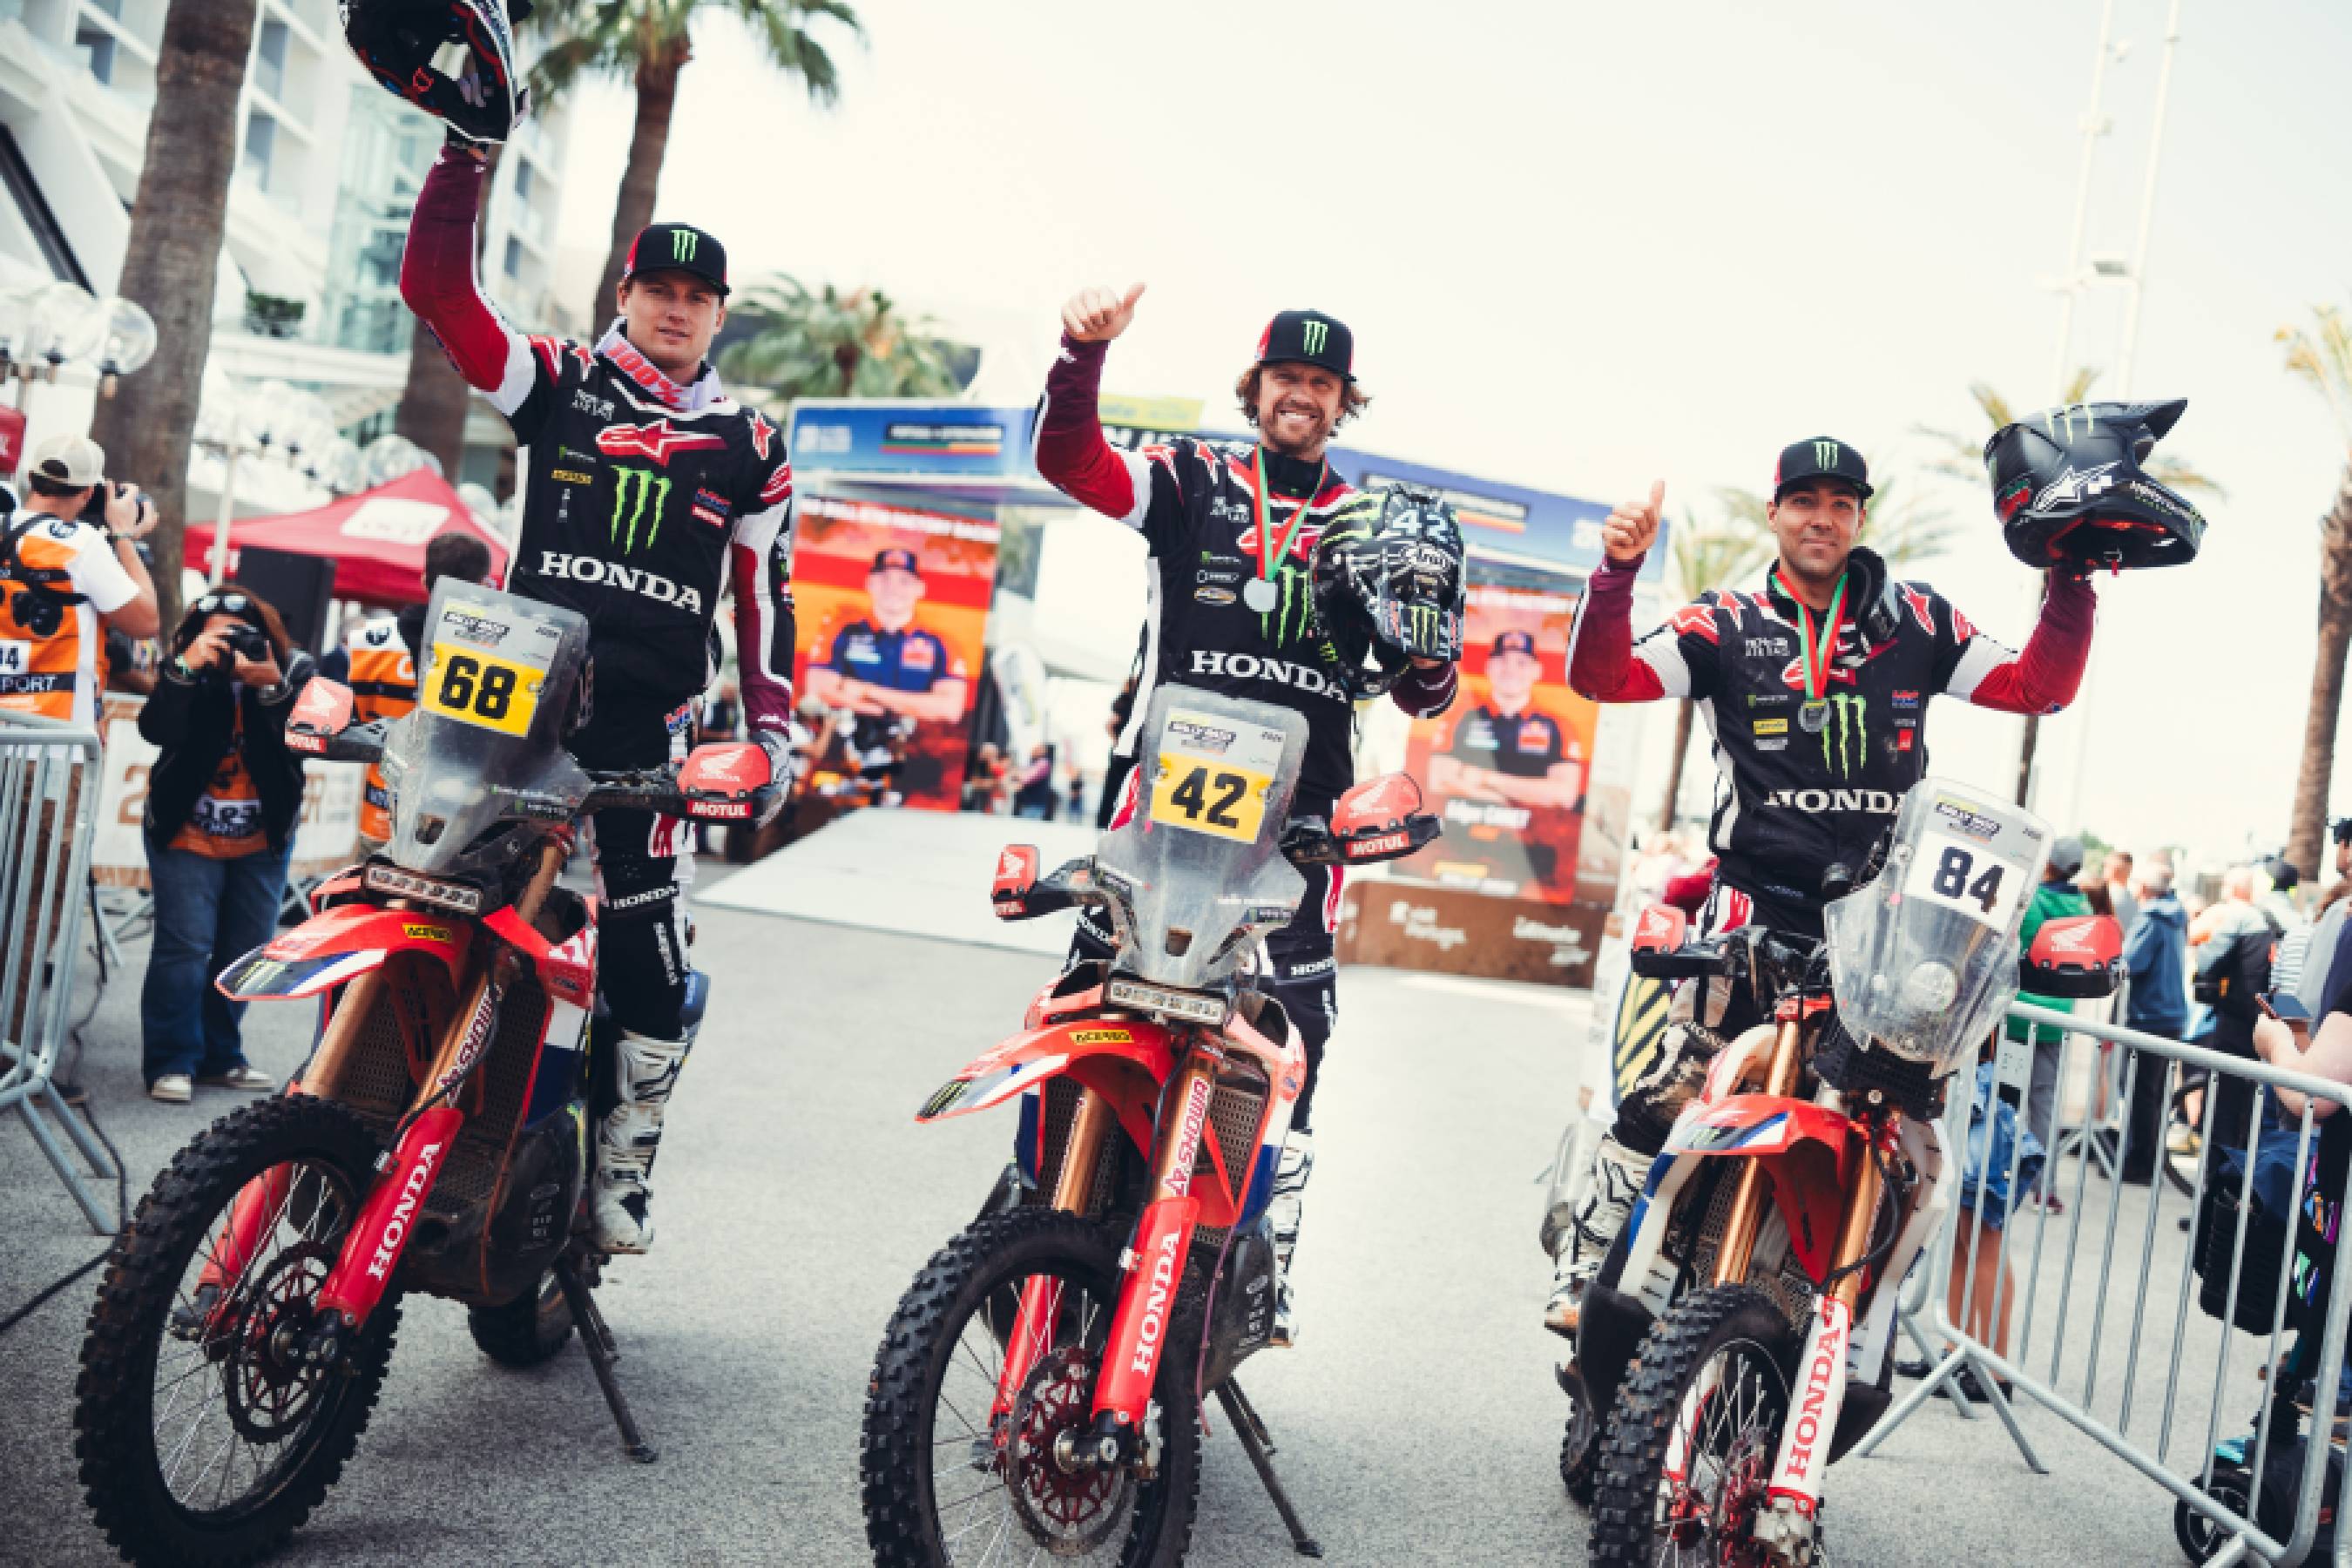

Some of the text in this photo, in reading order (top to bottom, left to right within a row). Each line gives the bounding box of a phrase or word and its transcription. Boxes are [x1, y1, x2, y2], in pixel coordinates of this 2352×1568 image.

[609, 341, 681, 404] 100%
[1392, 509, 1449, 542] 42
[538, 551, 702, 615] HONDA
[439, 654, 517, 720] 68
[693, 801, 748, 817] MOTUL
[1170, 767, 1247, 829] 42
[1350, 835, 1405, 855] MOTUL
[613, 884, 679, 910] HONDA
[1932, 845, 2005, 913] 84
[1176, 1077, 1212, 1173] SHOWA
[367, 1141, 443, 1281] HONDA
[1132, 1231, 1180, 1377] HONDA
[1784, 1321, 1842, 1483] HONDA
